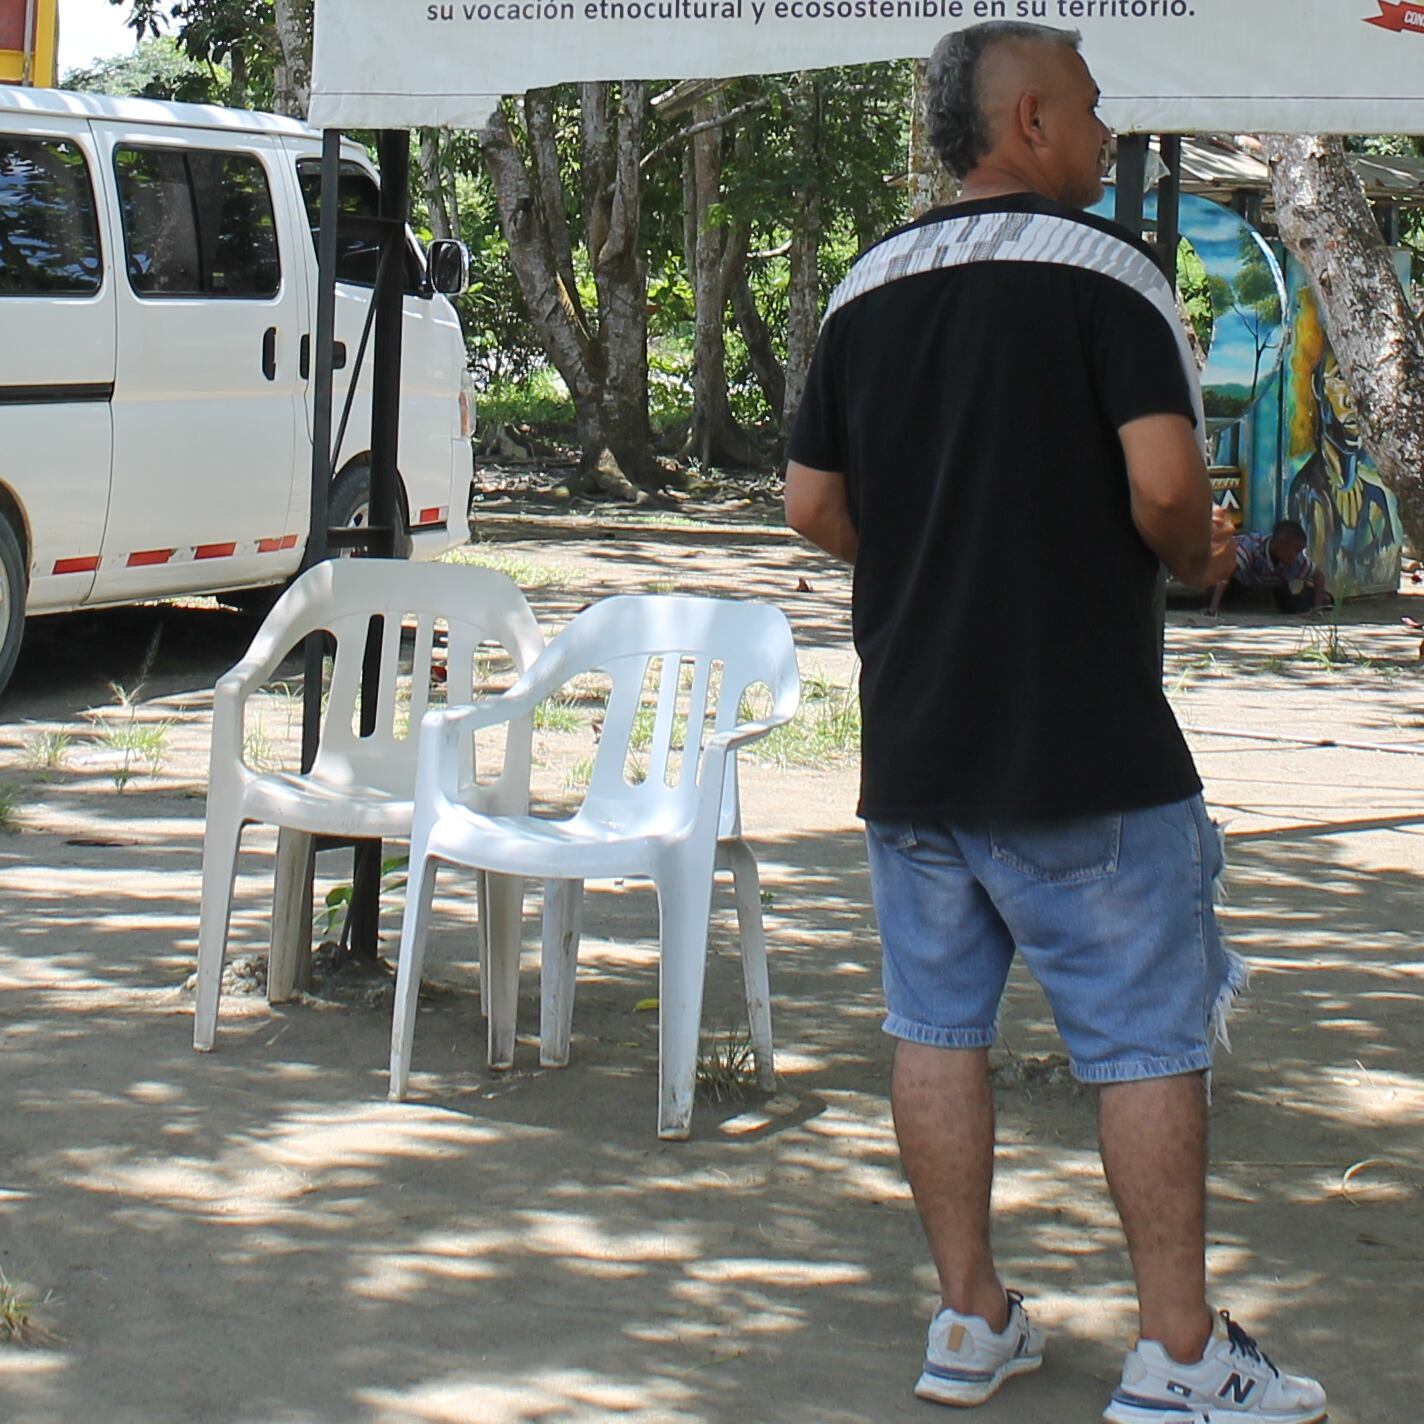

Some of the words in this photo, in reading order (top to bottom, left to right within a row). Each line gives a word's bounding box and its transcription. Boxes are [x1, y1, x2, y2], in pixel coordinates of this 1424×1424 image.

[426, 3, 454, 21] su
[751, 1, 766, 25] y
[973, 0, 1006, 18] en
[1015, 0, 1047, 17] su
[1216, 1371, 1257, 1405] N
